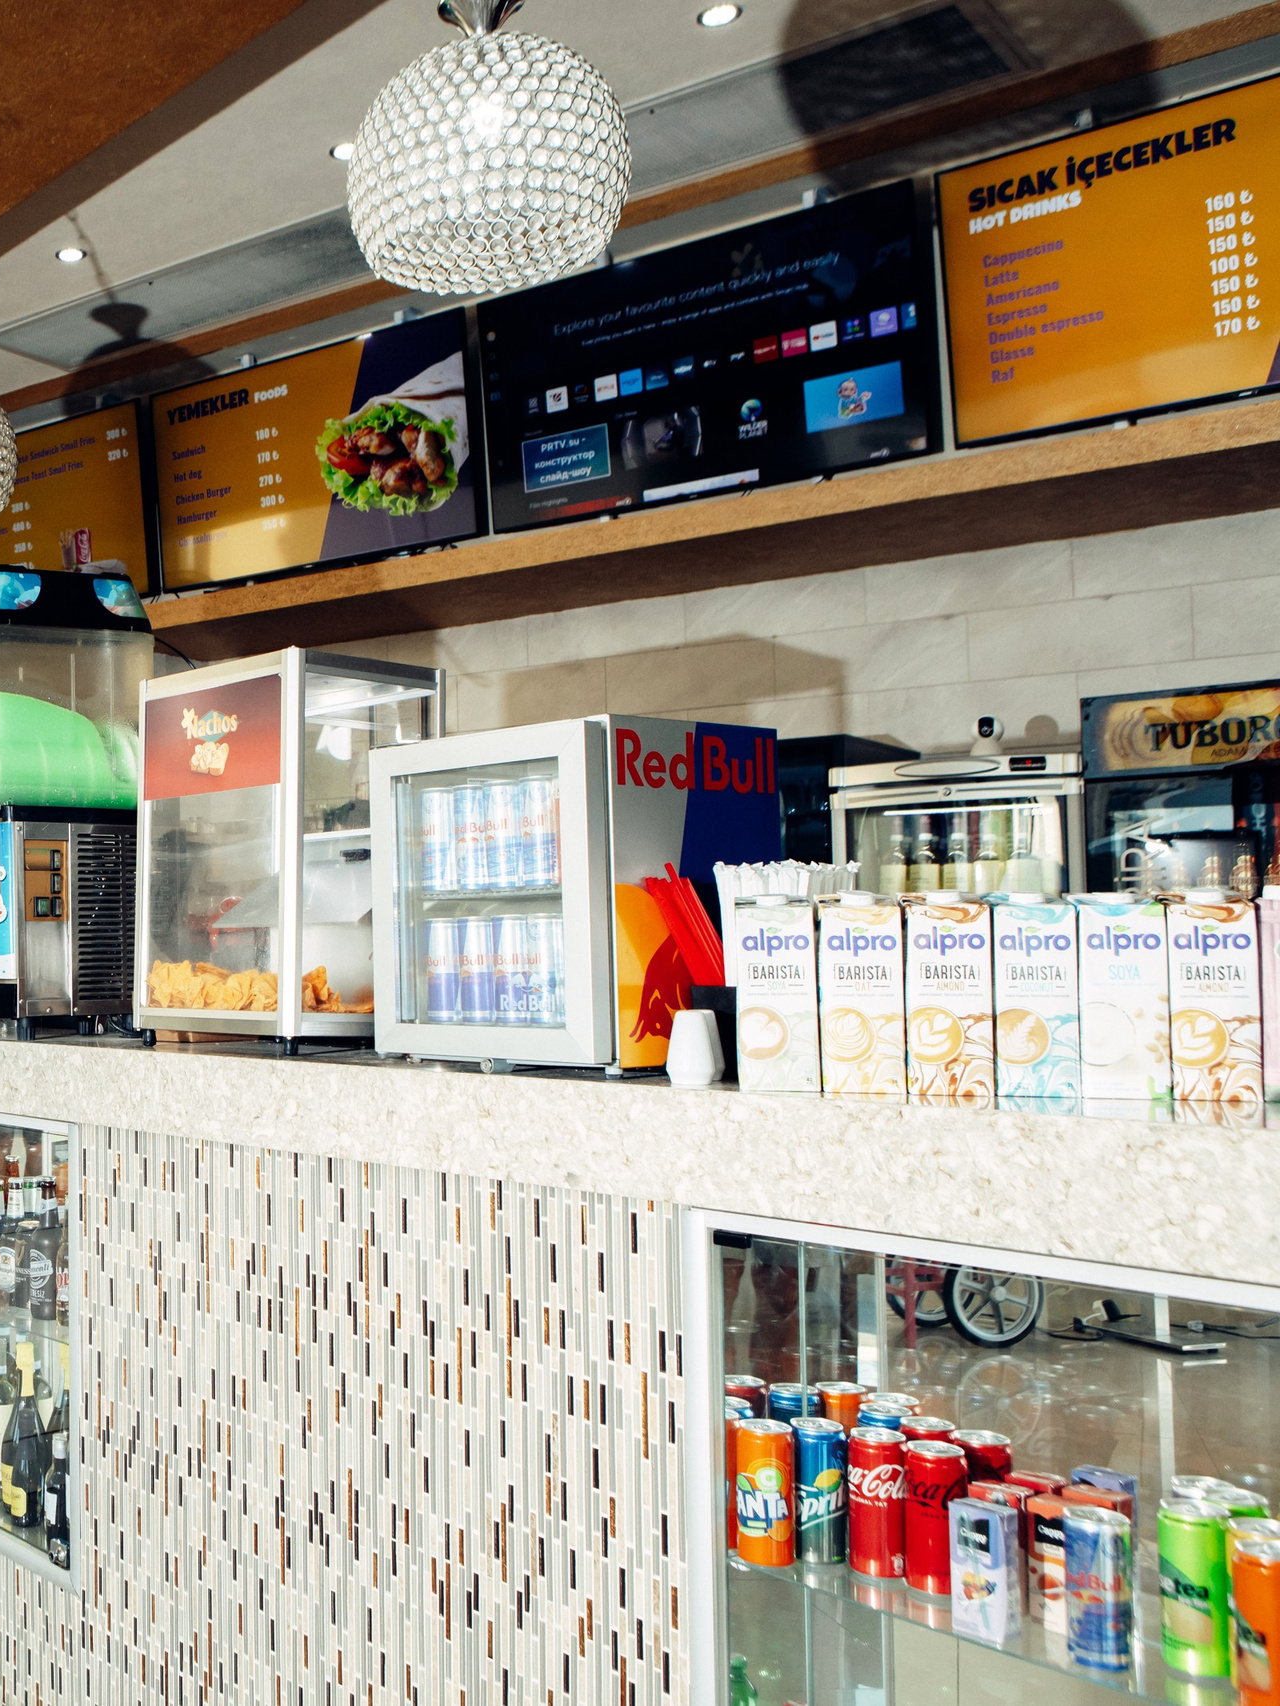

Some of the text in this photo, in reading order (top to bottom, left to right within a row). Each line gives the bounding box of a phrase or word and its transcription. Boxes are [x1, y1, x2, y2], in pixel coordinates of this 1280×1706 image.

[968, 118, 1237, 213] SICAK İÇECEKLER
[969, 189, 1082, 235] HOT DRINKS
[983, 240, 1063, 268] Cappuccino
[1205, 191, 1235, 213] 160
[984, 270, 1019, 288] Latte
[1206, 212, 1236, 234] 150
[986, 281, 1060, 307] Americano
[1208, 233, 1237, 255] 150
[554, 251, 840, 336] Explore your favourite content quickly and easily
[987, 303, 1047, 326] Espresso
[1209, 254, 1239, 275] 100
[988, 324, 1036, 345] Double
[1041, 310, 1104, 333] espresso
[1211, 275, 1240, 296] 150
[990, 346, 1034, 364] Glasse
[1212, 295, 1241, 317] 150
[991, 367, 1014, 384] Raf
[1214, 317, 1242, 338] 170
[167, 384, 288, 425] YEMEKLER FOODS
[60, 438, 78, 452] Small
[80, 437, 96, 446] Fries
[172, 445, 206, 461] Sandwich
[541, 438, 579, 452] PRTV.su
[534, 450, 595, 469] конструктор
[31, 470, 47, 481] Toast
[49, 464, 66, 477] Small
[68, 461, 84, 471] Fries
[174, 472, 186, 483] Hot
[188, 469, 202, 481] dog
[540, 466, 592, 484] слайд-шоу
[175, 492, 205, 506] Chicken
[206, 486, 231, 501] Burger
[176, 510, 217, 525] Hamburger
[183, 709, 238, 739] Nachos
[616, 728, 775, 794] Red Bull
[486, 818, 507, 832] Bull
[523, 814, 544, 828] Bull
[742, 928, 810, 957] alpro
[827, 927, 897, 957] alpro
[913, 925, 985, 956] alpro
[999, 926, 1071, 957] alpro
[1086, 925, 1161, 956] alpro
[1173, 925, 1252, 956] alpro
[753, 964, 801, 979] BARISTA
[838, 965, 888, 981] BARISTA
[924, 964, 975, 980] BARISTA
[1011, 965, 1062, 981] BARISTA
[1108, 964, 1141, 980] SOYA
[1185, 965, 1241, 981] BARISTA
[855, 981, 871, 992] OAT
[936, 981, 965, 991] ALMOND
[1020, 981, 1055, 992] COCONUT
[1198, 982, 1229, 993] ALMOND
[500, 993, 556, 1012] Red Bull
[737, 1489, 789, 1519] ANTA
[1088, 1573, 1123, 1593] Bull
